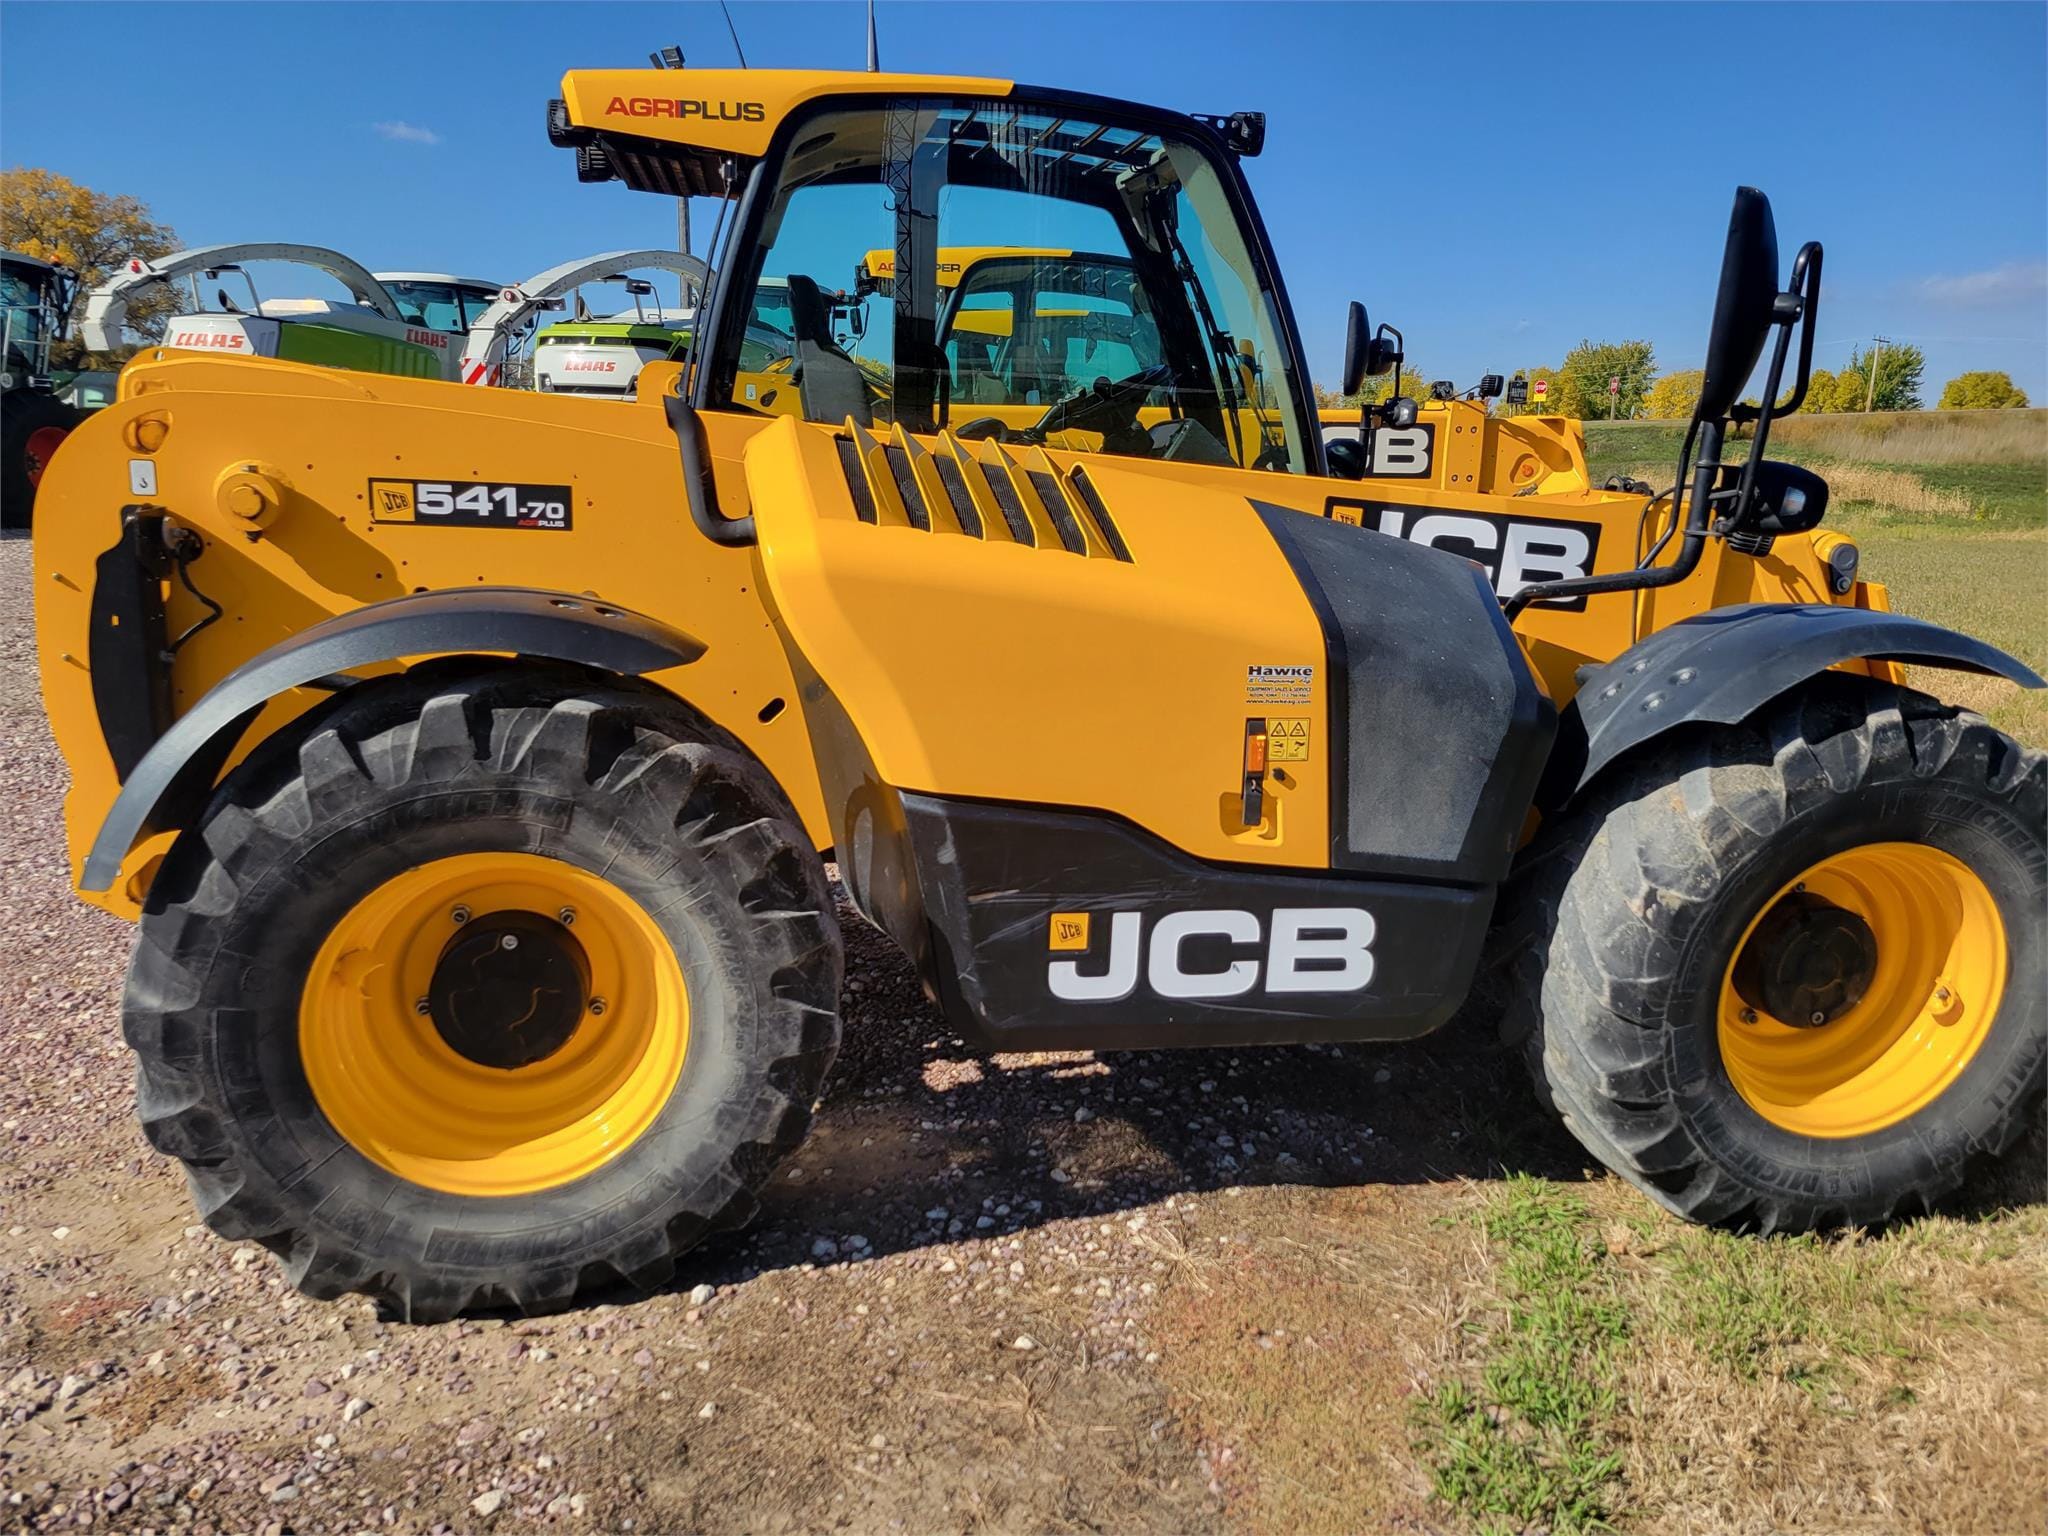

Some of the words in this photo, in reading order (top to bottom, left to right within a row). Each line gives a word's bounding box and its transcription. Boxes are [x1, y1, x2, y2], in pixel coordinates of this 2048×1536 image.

[604, 96, 766, 122] AGRIPLUS
[175, 332, 246, 349] CLAAS
[406, 328, 449, 349] CLAAS
[564, 360, 617, 373] CLAAS
[384, 491, 410, 510] JCB
[416, 483, 566, 519] 541-70
[517, 518, 565, 528] AGRIPLUS
[1248, 665, 1313, 676] Hawke
[1059, 922, 1083, 940] JCB
[1048, 907, 1377, 1001] JCB
